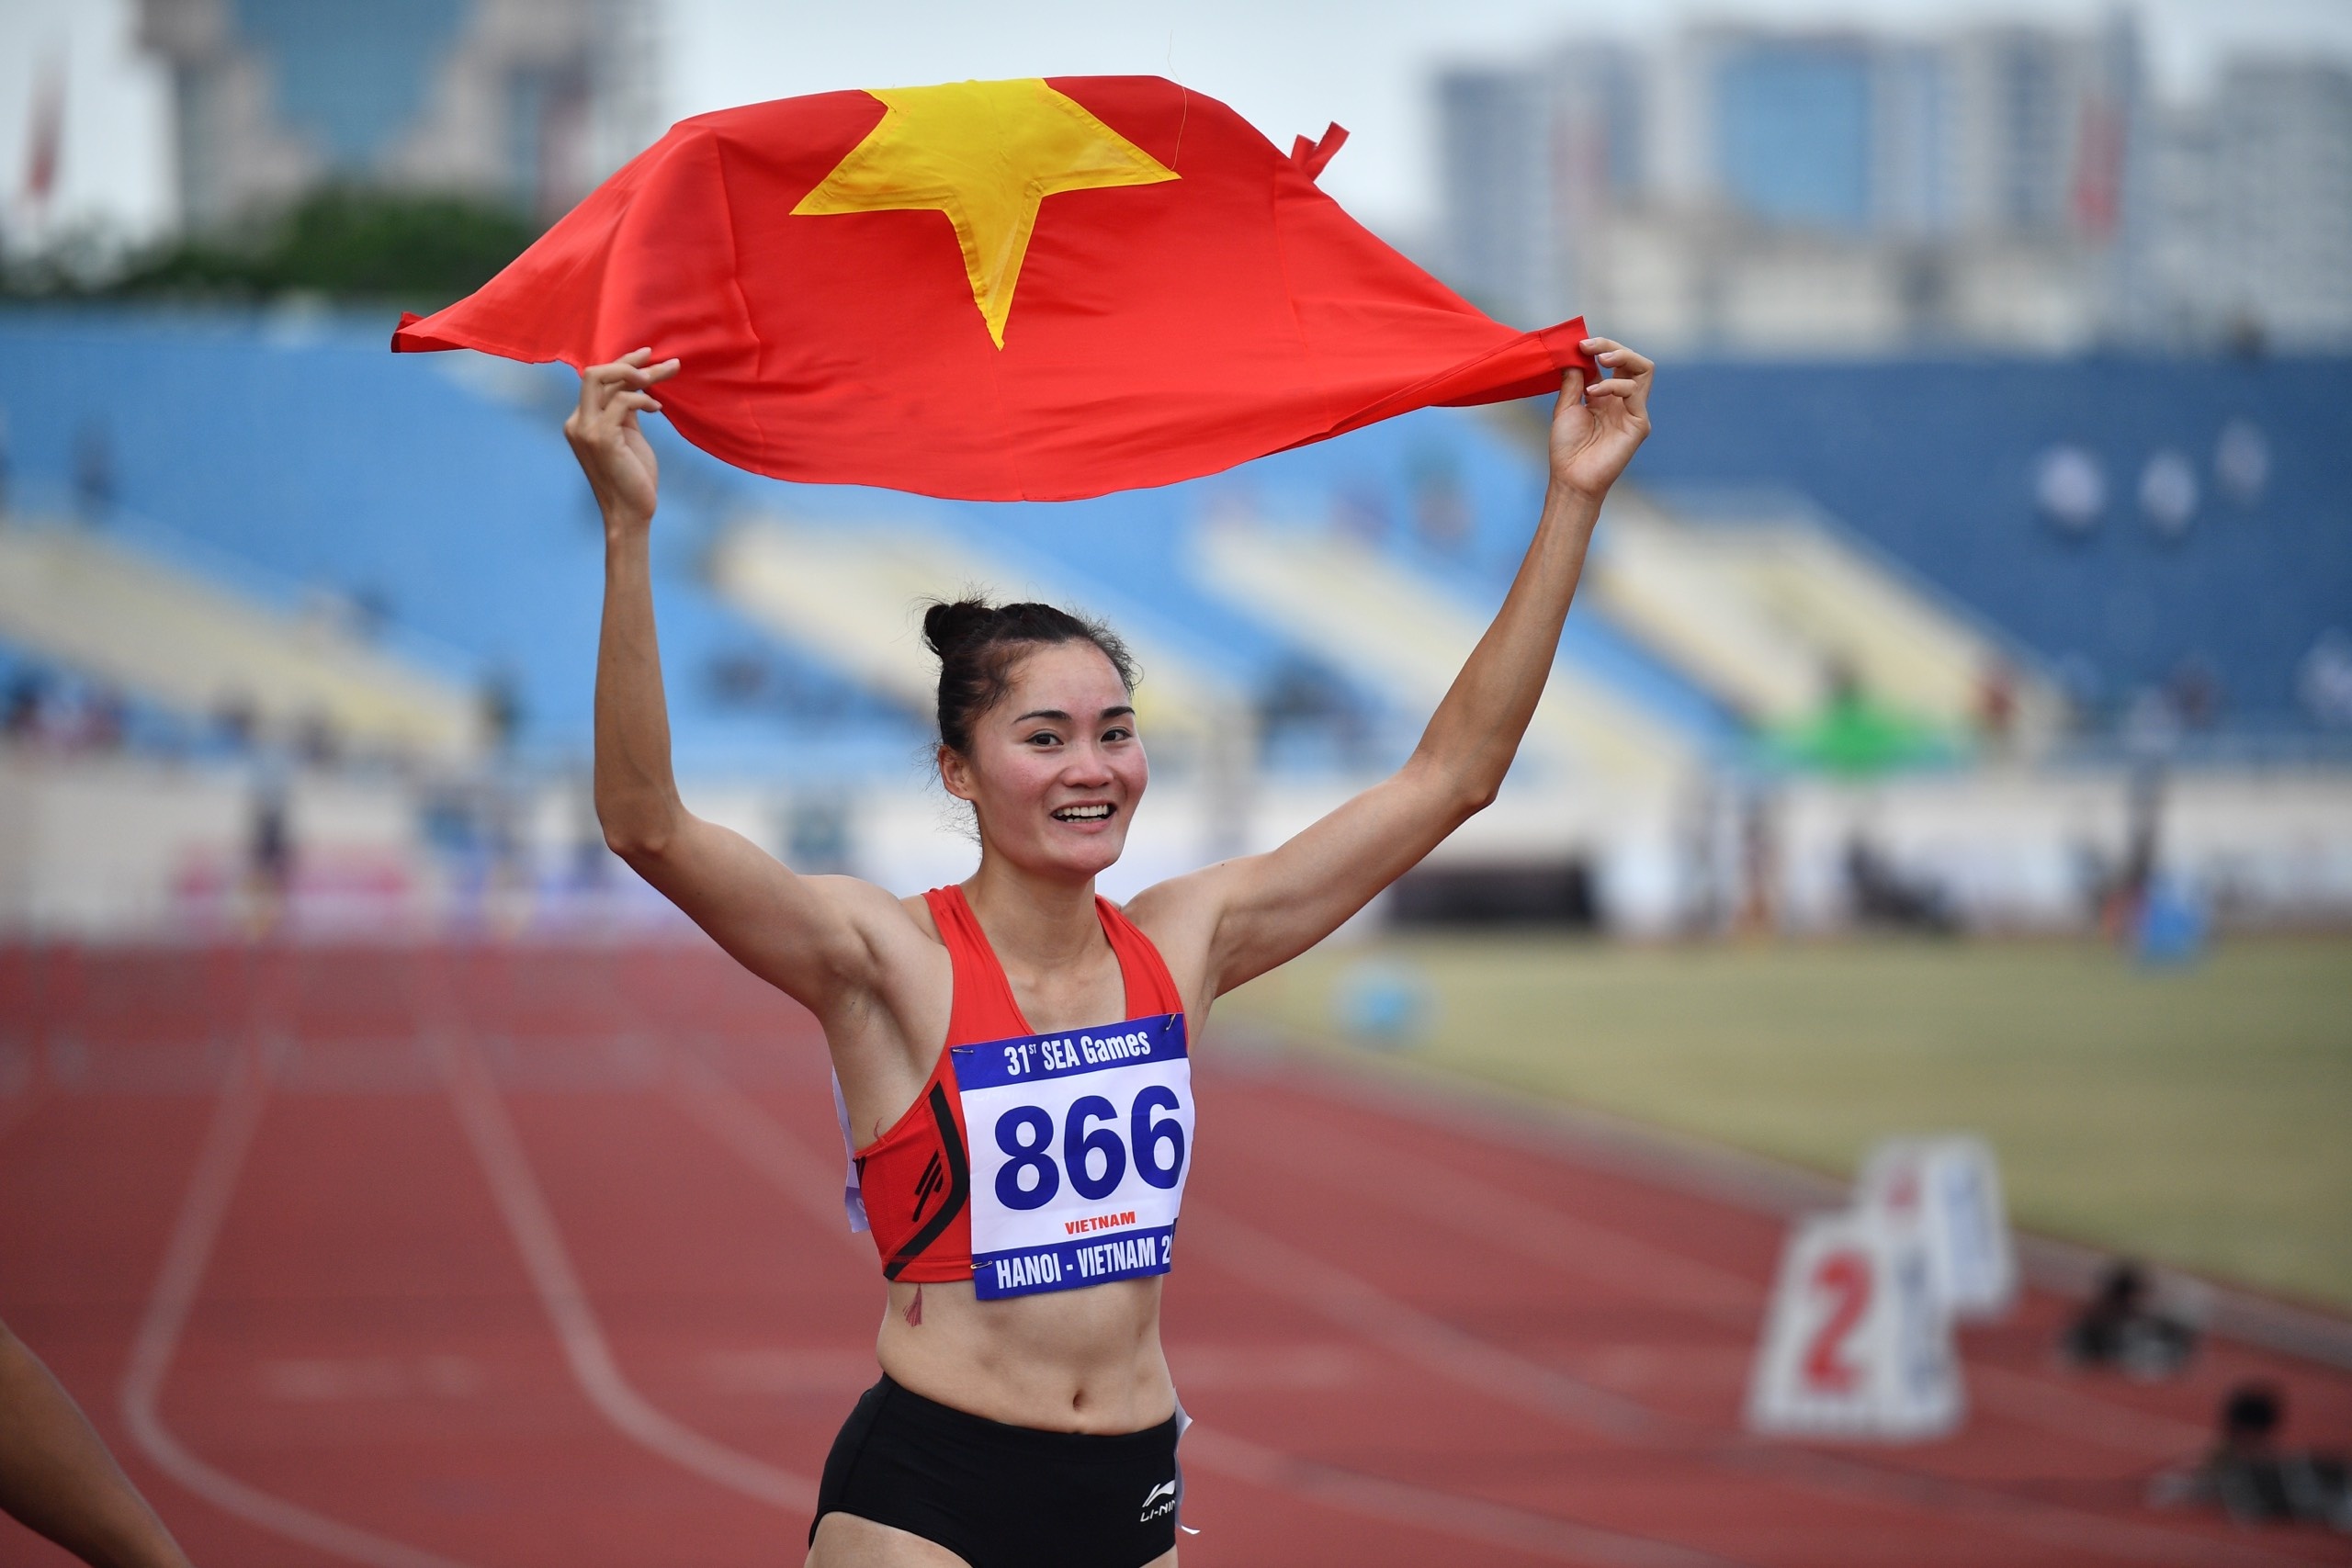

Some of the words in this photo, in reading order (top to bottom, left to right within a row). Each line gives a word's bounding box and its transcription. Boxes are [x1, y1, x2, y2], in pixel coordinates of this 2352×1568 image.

[1041, 1039, 1080, 1071] SEA
[1080, 1031, 1151, 1065] Games
[995, 1085, 1184, 1211] 866
[1065, 1211, 1136, 1235] VIETNAM
[996, 1253, 1062, 1289] HANOI
[1076, 1236, 1156, 1278] VIETNAM
[1161, 1234, 1172, 1264] 2
[1803, 1247, 1875, 1398] 2
